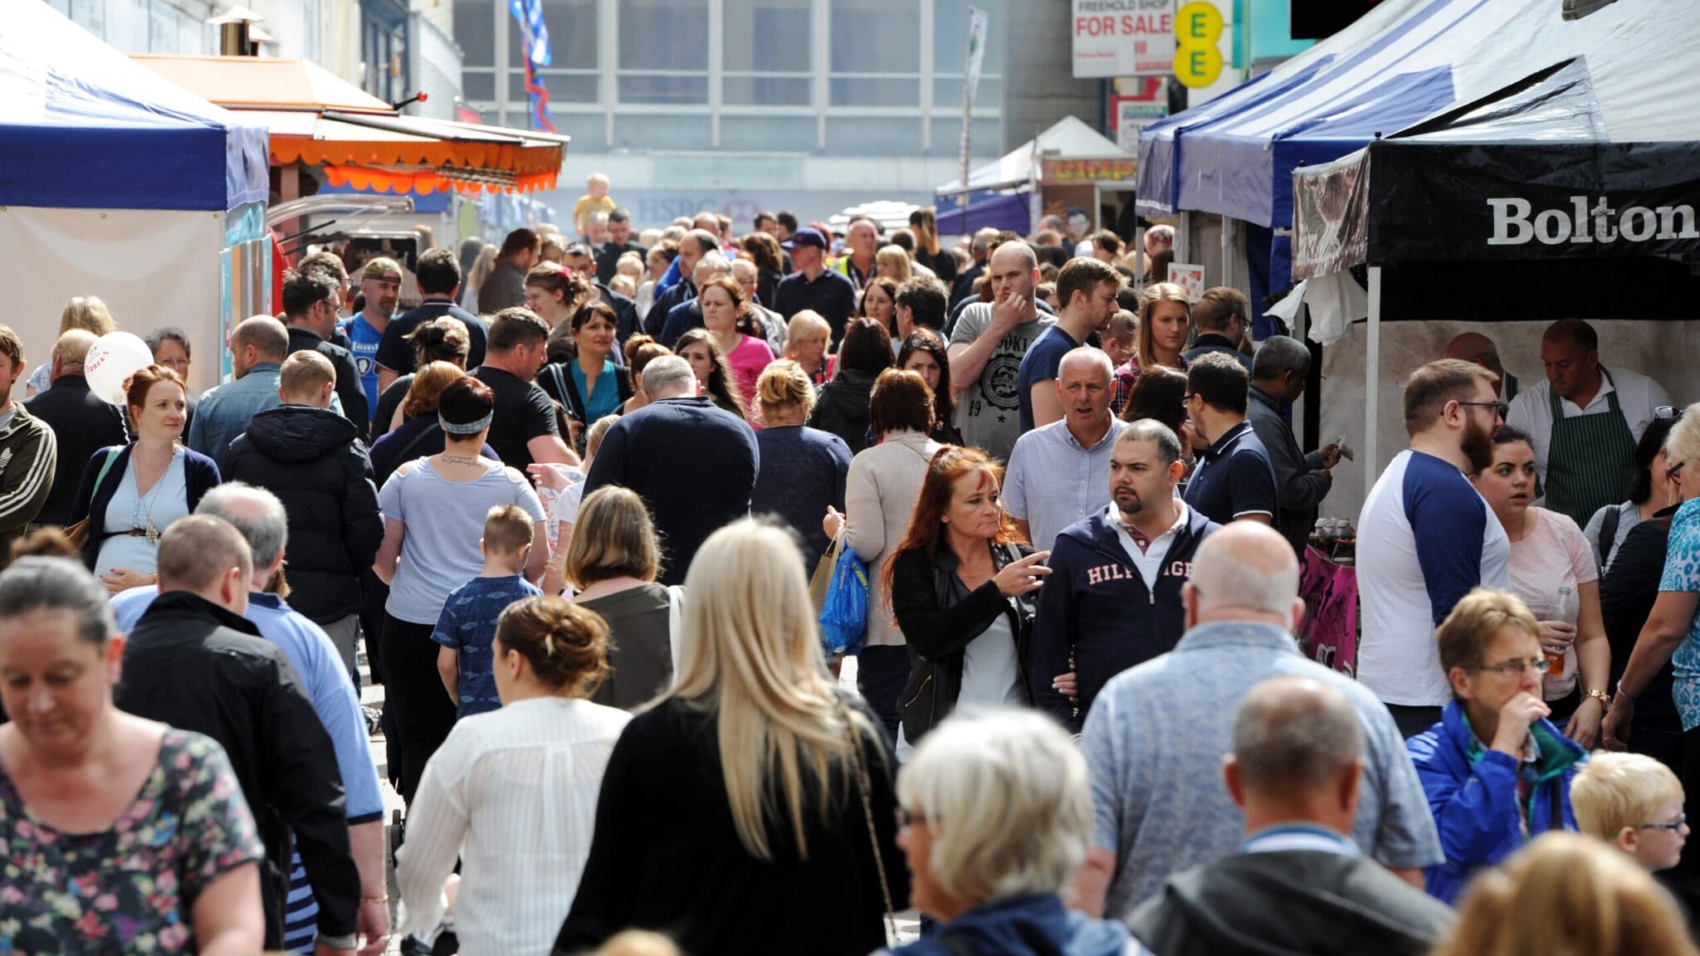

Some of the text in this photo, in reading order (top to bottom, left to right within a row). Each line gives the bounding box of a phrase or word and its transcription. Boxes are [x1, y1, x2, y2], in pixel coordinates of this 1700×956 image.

[1078, 0, 1170, 12] FREEHOLD SHOP
[1076, 14, 1172, 37] FOR SALE
[1487, 195, 1700, 245] Bolton
[968, 400, 982, 417] 19
